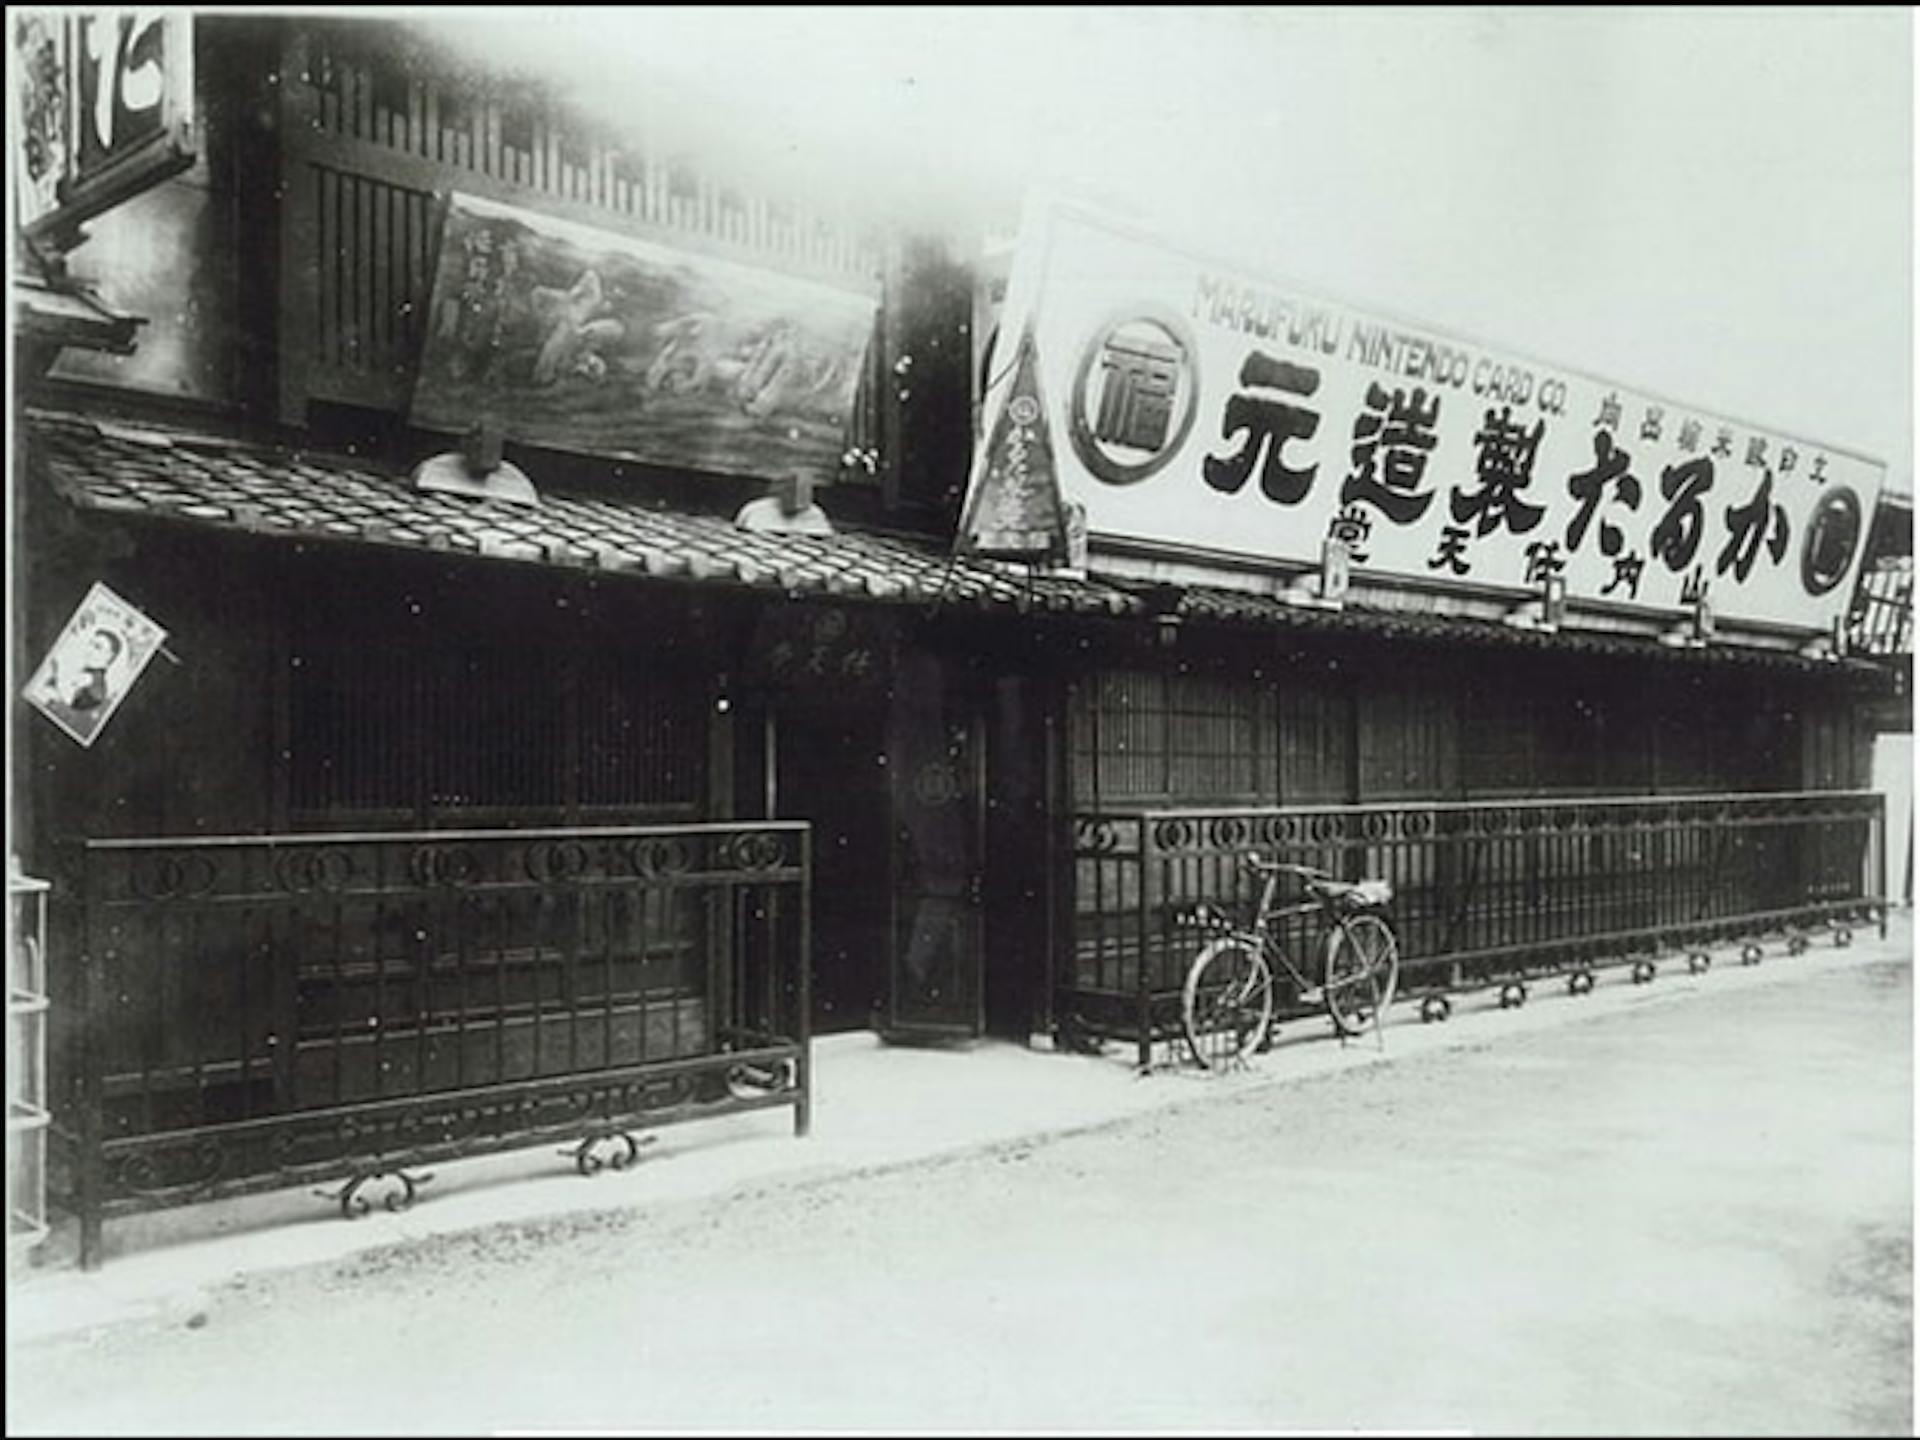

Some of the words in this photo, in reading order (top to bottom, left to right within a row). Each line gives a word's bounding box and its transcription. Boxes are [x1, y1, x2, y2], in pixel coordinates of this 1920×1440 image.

[1192, 273, 1343, 356] MARUFUKU
[1346, 323, 1468, 390] NINTENDO
[1472, 357, 1534, 407] CARD
